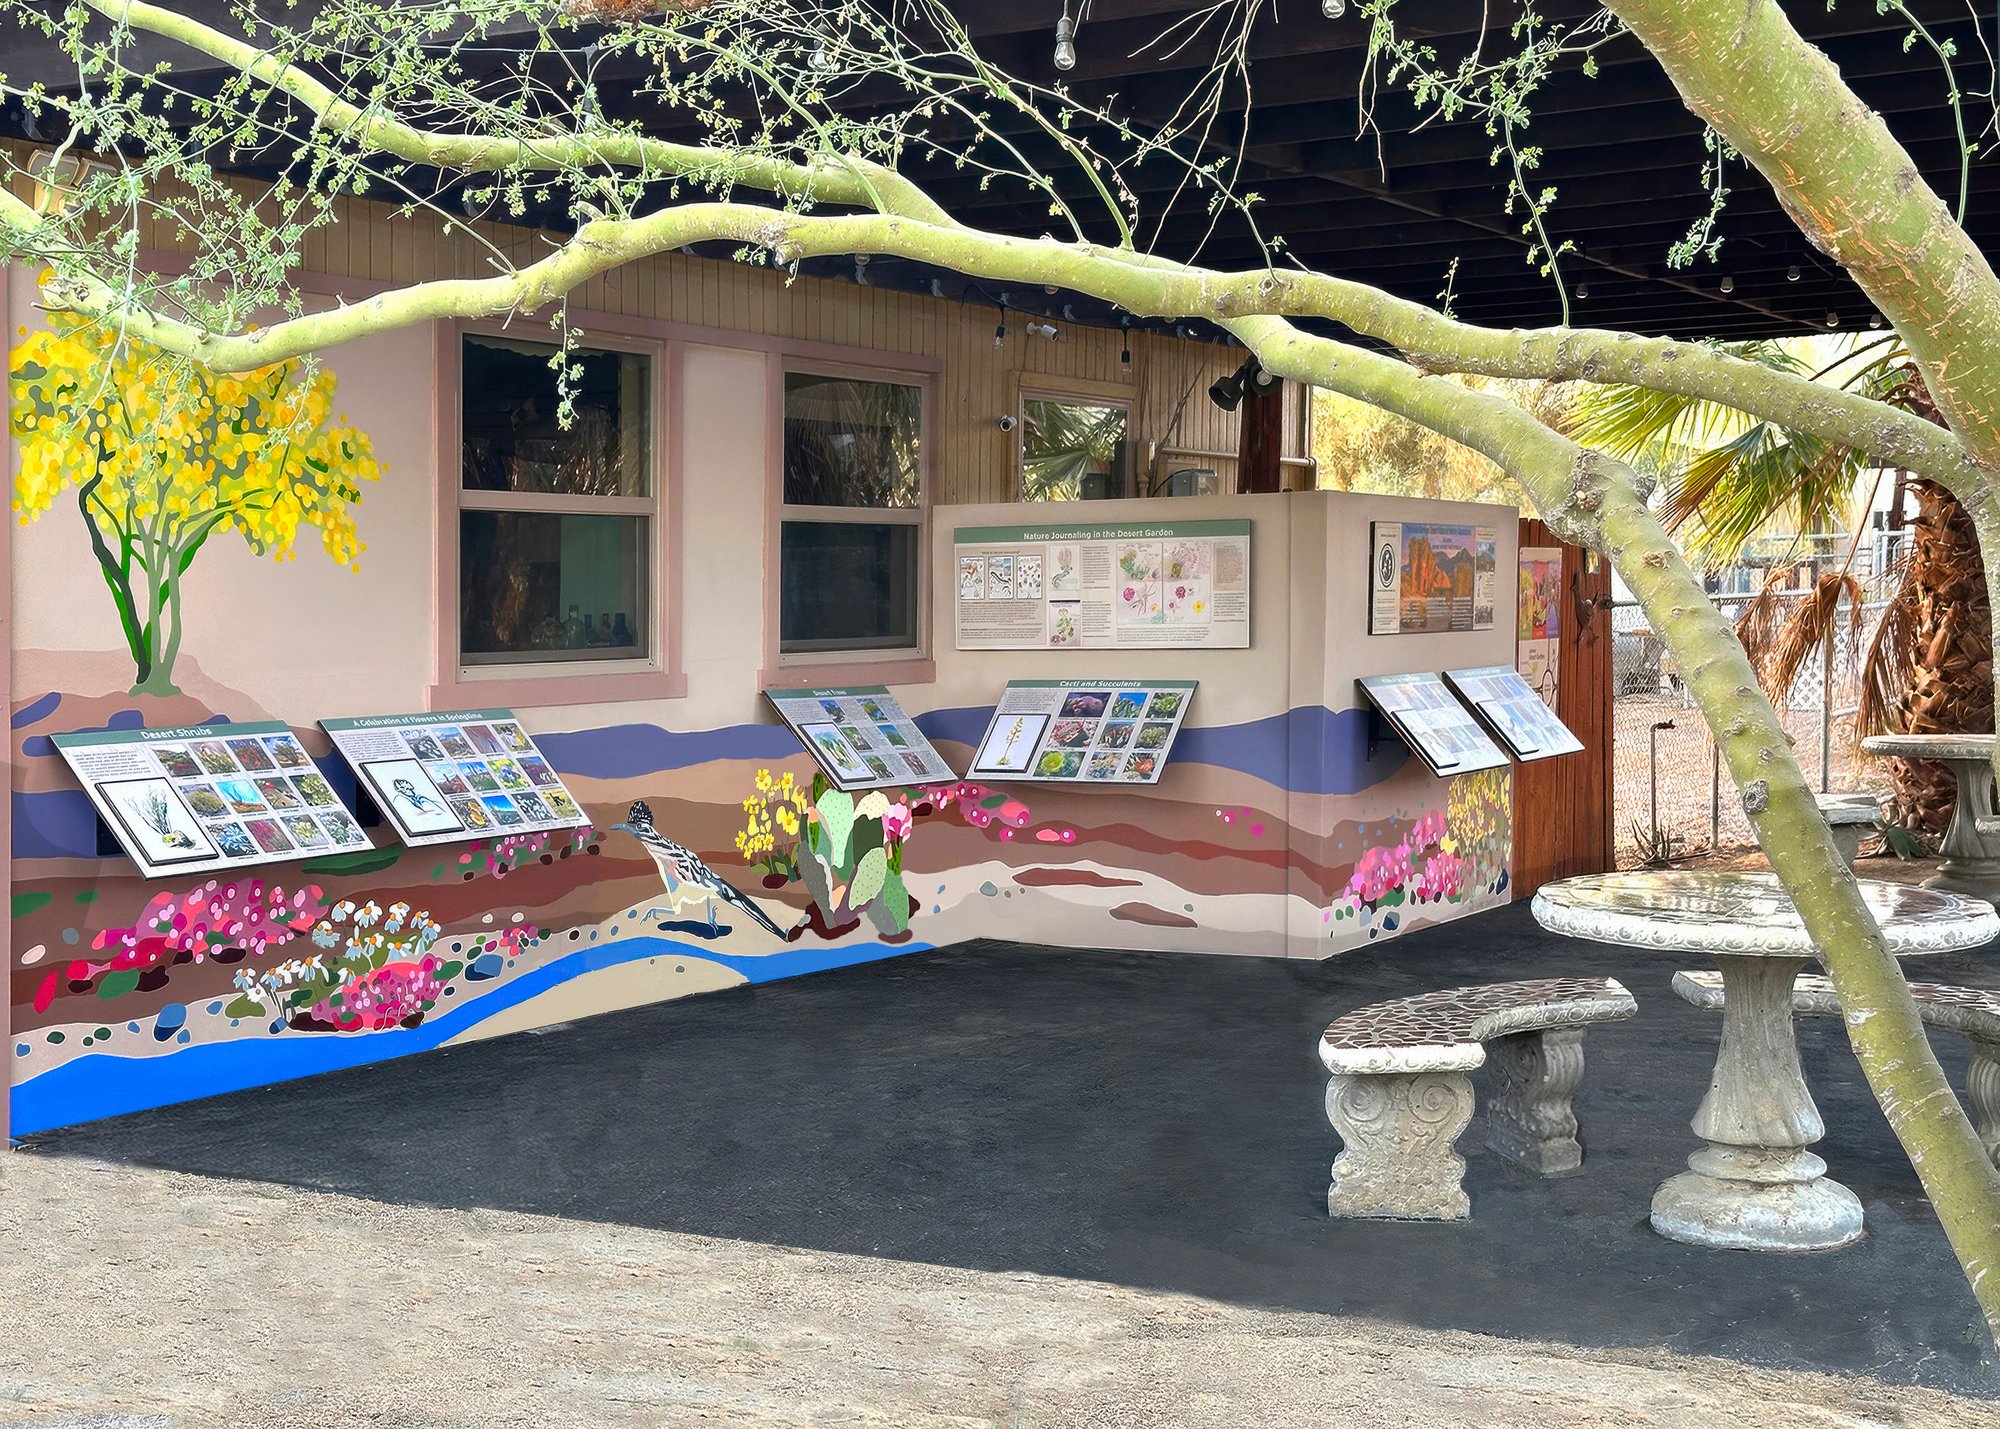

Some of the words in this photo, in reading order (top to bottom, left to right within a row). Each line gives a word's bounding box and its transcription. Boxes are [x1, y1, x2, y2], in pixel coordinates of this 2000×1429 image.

[1024, 532, 1050, 540] Nature
[1051, 531, 1091, 541] Journaling
[1093, 530, 1100, 538] in
[1102, 530, 1116, 538] the
[1117, 529, 1143, 538] Desert
[1144, 528, 1173, 537] Garden
[360, 717, 400, 727] Celebration
[400, 717, 410, 725] of
[409, 714, 437, 724] Flowers
[445, 712, 483, 722] Springtime
[140, 729, 177, 740] Desert
[176, 726, 213, 738] Shrubs
